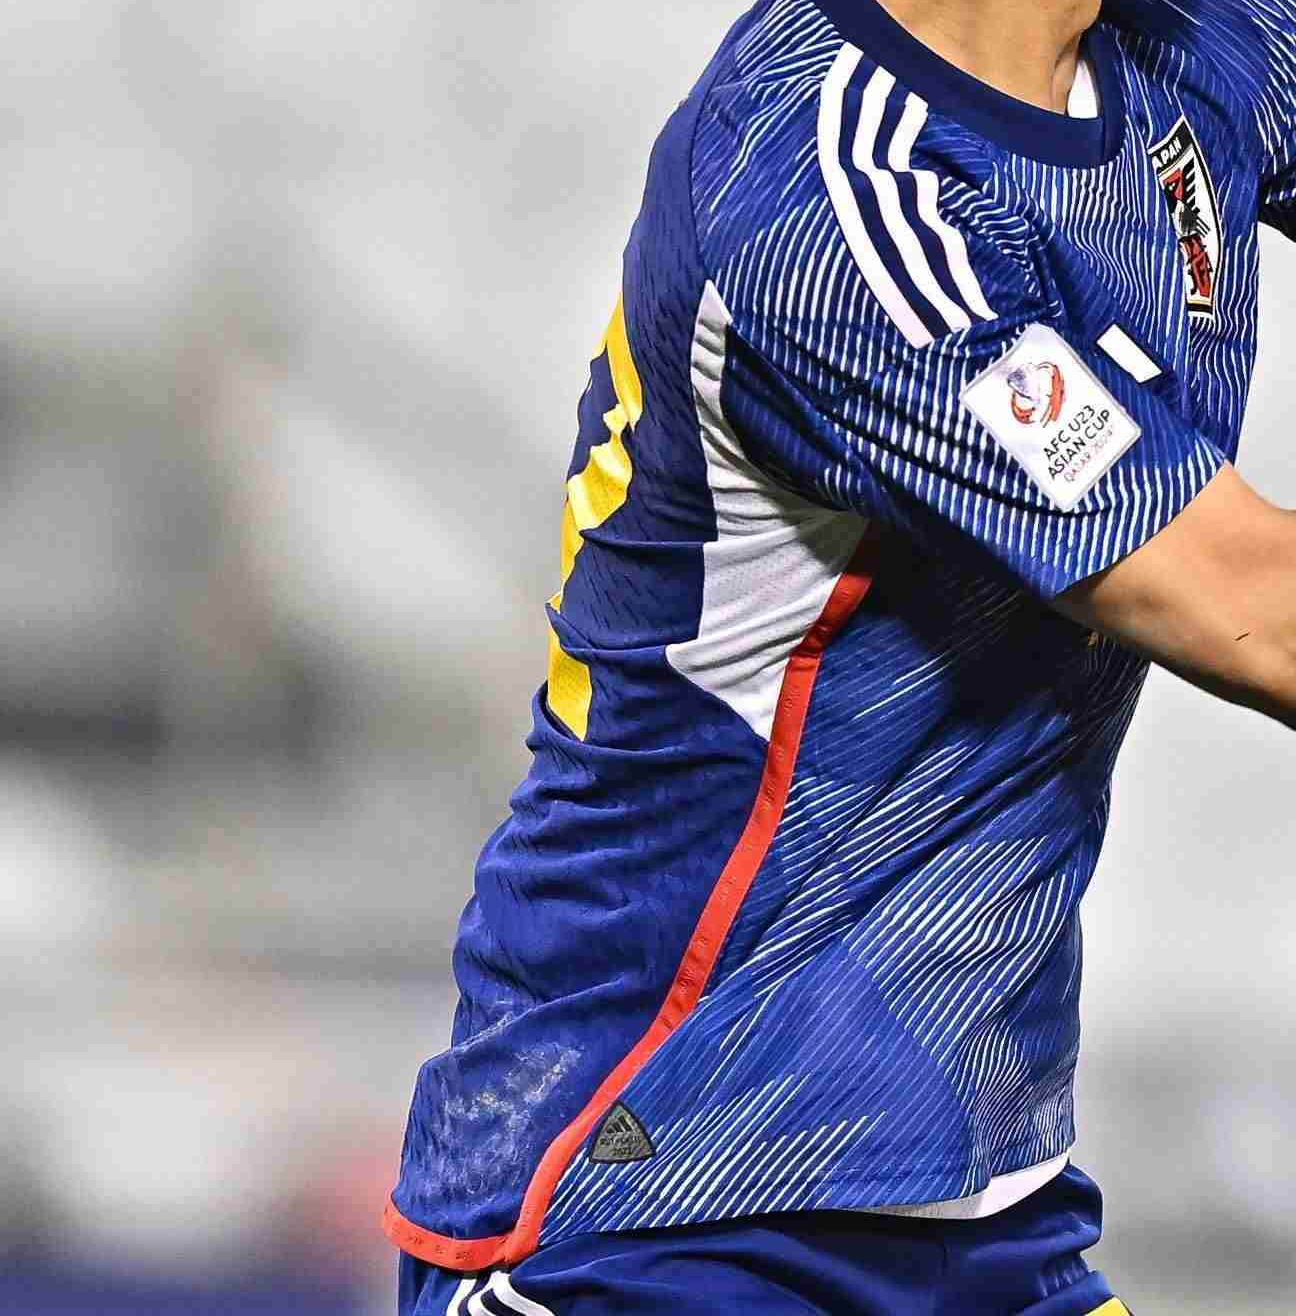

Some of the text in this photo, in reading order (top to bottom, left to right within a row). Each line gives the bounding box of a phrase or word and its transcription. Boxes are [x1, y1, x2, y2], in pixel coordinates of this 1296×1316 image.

[1151, 136, 1182, 175] APAN
[1043, 405, 1096, 462] AFC U23
[1047, 437, 1087, 481] ASIAN
[1084, 409, 1110, 439] CUP
